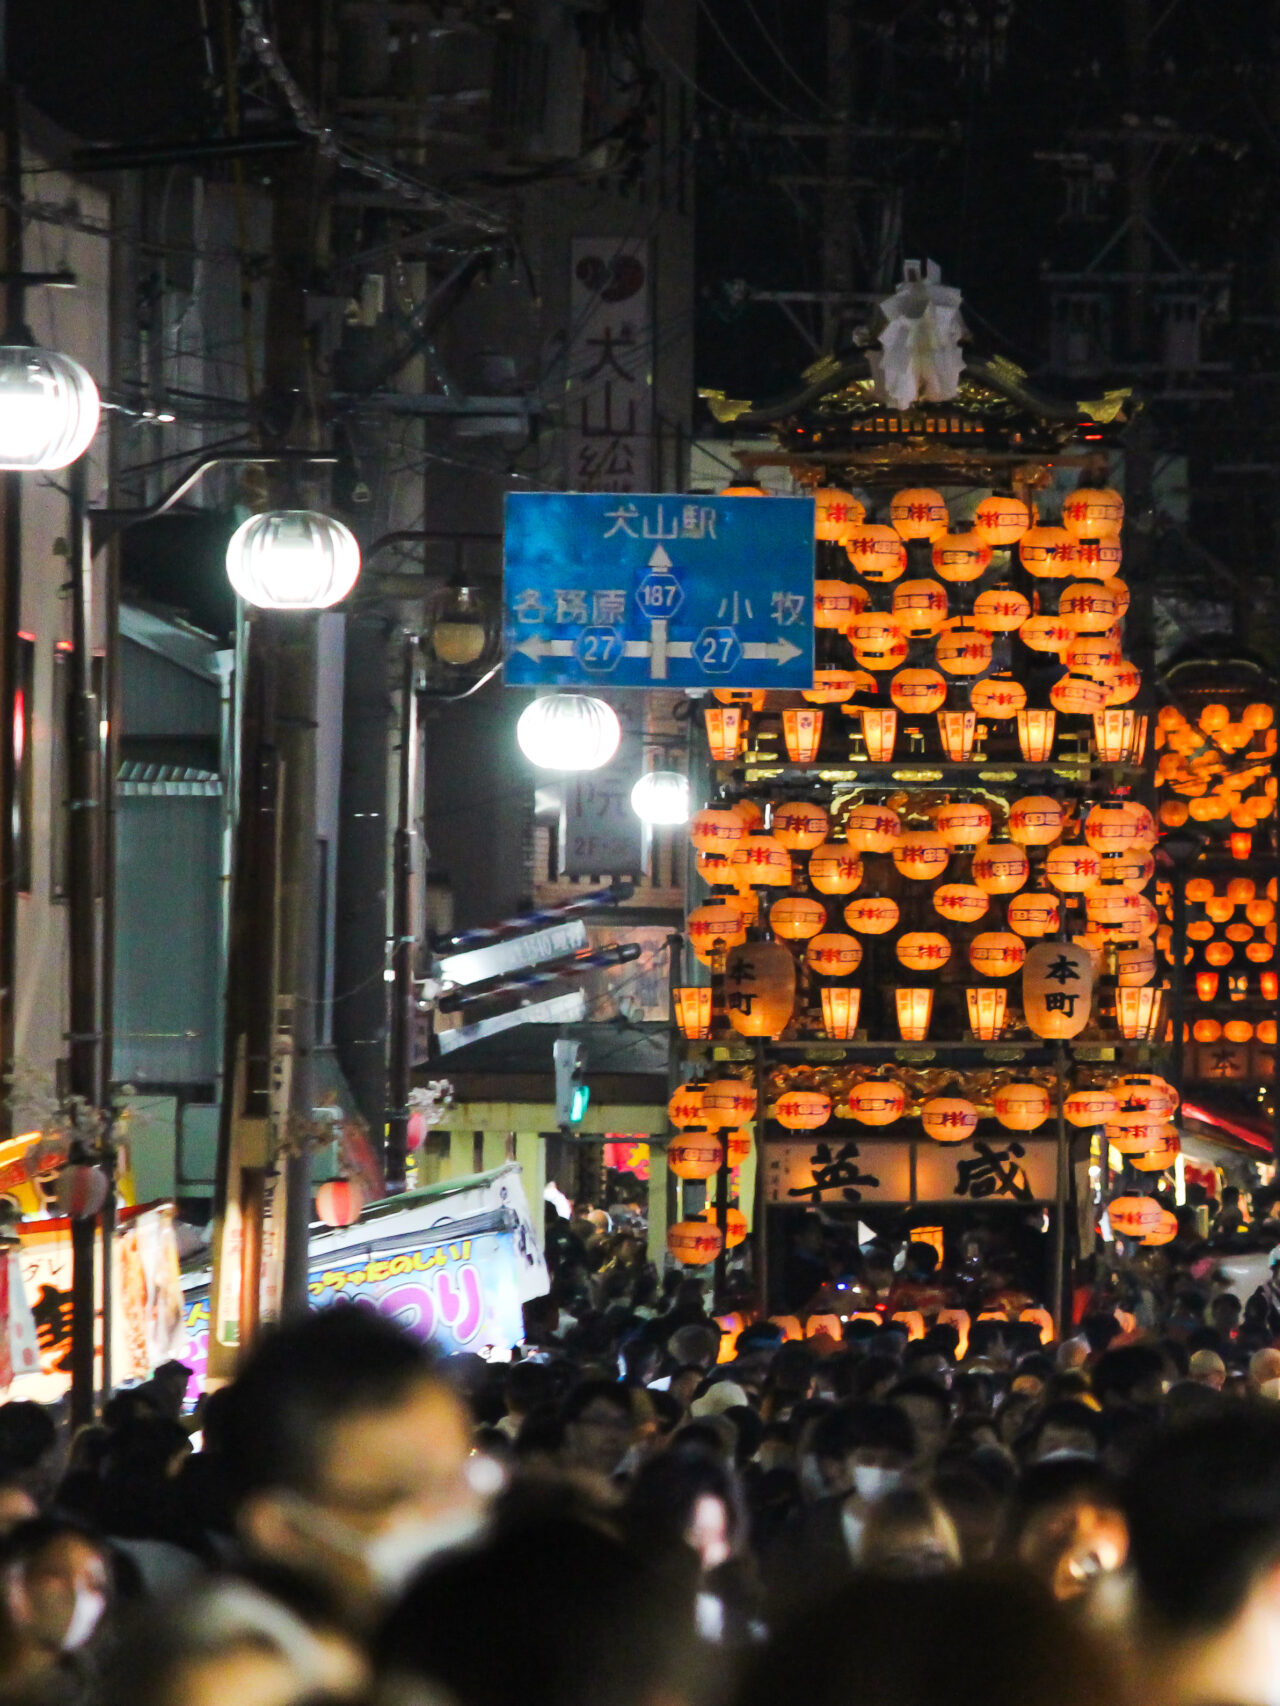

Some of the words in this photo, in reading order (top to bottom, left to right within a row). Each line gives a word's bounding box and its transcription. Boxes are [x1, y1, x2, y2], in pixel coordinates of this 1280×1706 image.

[603, 503, 718, 540] 犬山駅
[513, 588, 627, 624] 各務原
[643, 586, 676, 607] 187
[717, 590, 806, 626] 小牧
[583, 636, 616, 662] 27
[702, 638, 734, 664] 27
[728, 957, 759, 1017] 本町
[1044, 954, 1081, 1018] 本町
[333, 1264, 484, 1346] つり
